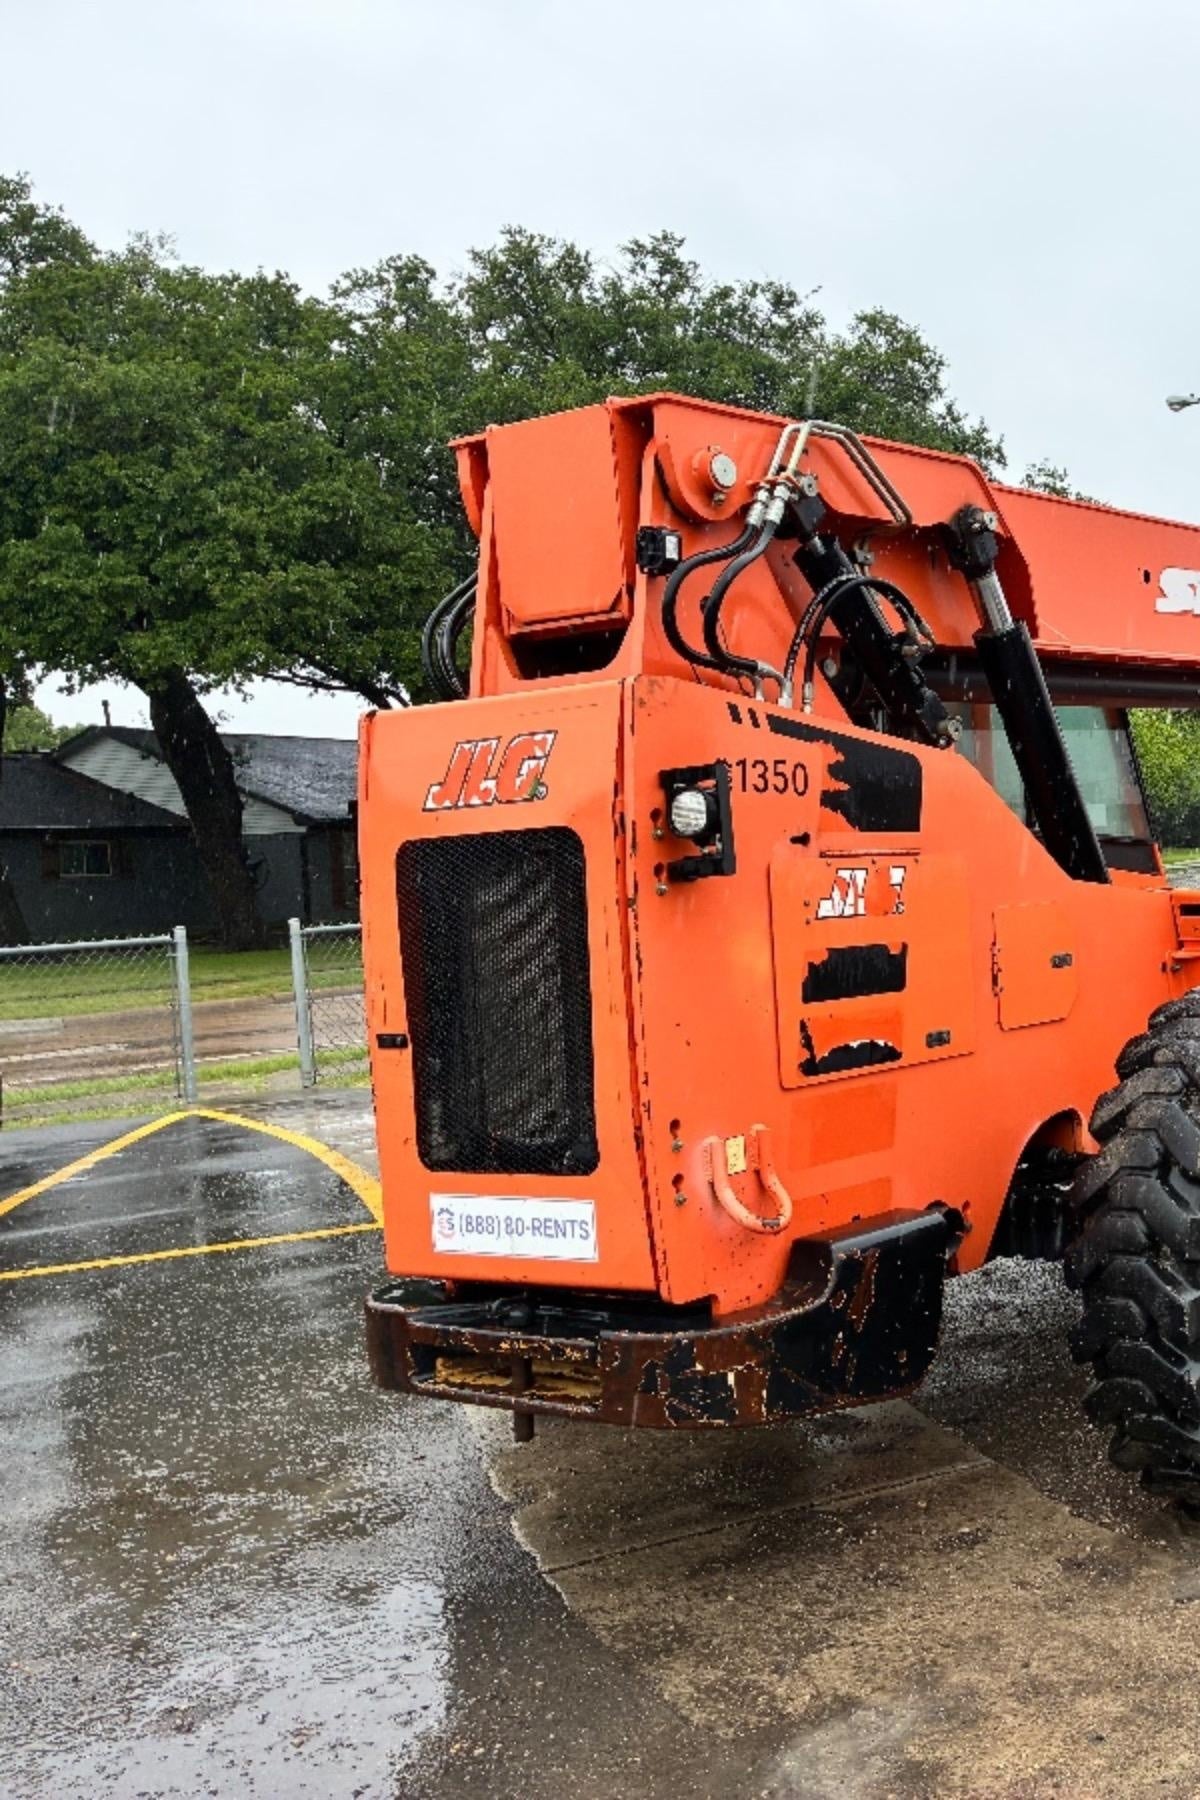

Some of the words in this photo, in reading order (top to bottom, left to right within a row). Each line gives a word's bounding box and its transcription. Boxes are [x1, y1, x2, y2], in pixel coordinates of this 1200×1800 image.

[422, 730, 558, 811] JLG
[727, 757, 809, 797] 1350
[459, 1213, 501, 1240] (888)
[504, 1216, 590, 1241] 80-RENTS
